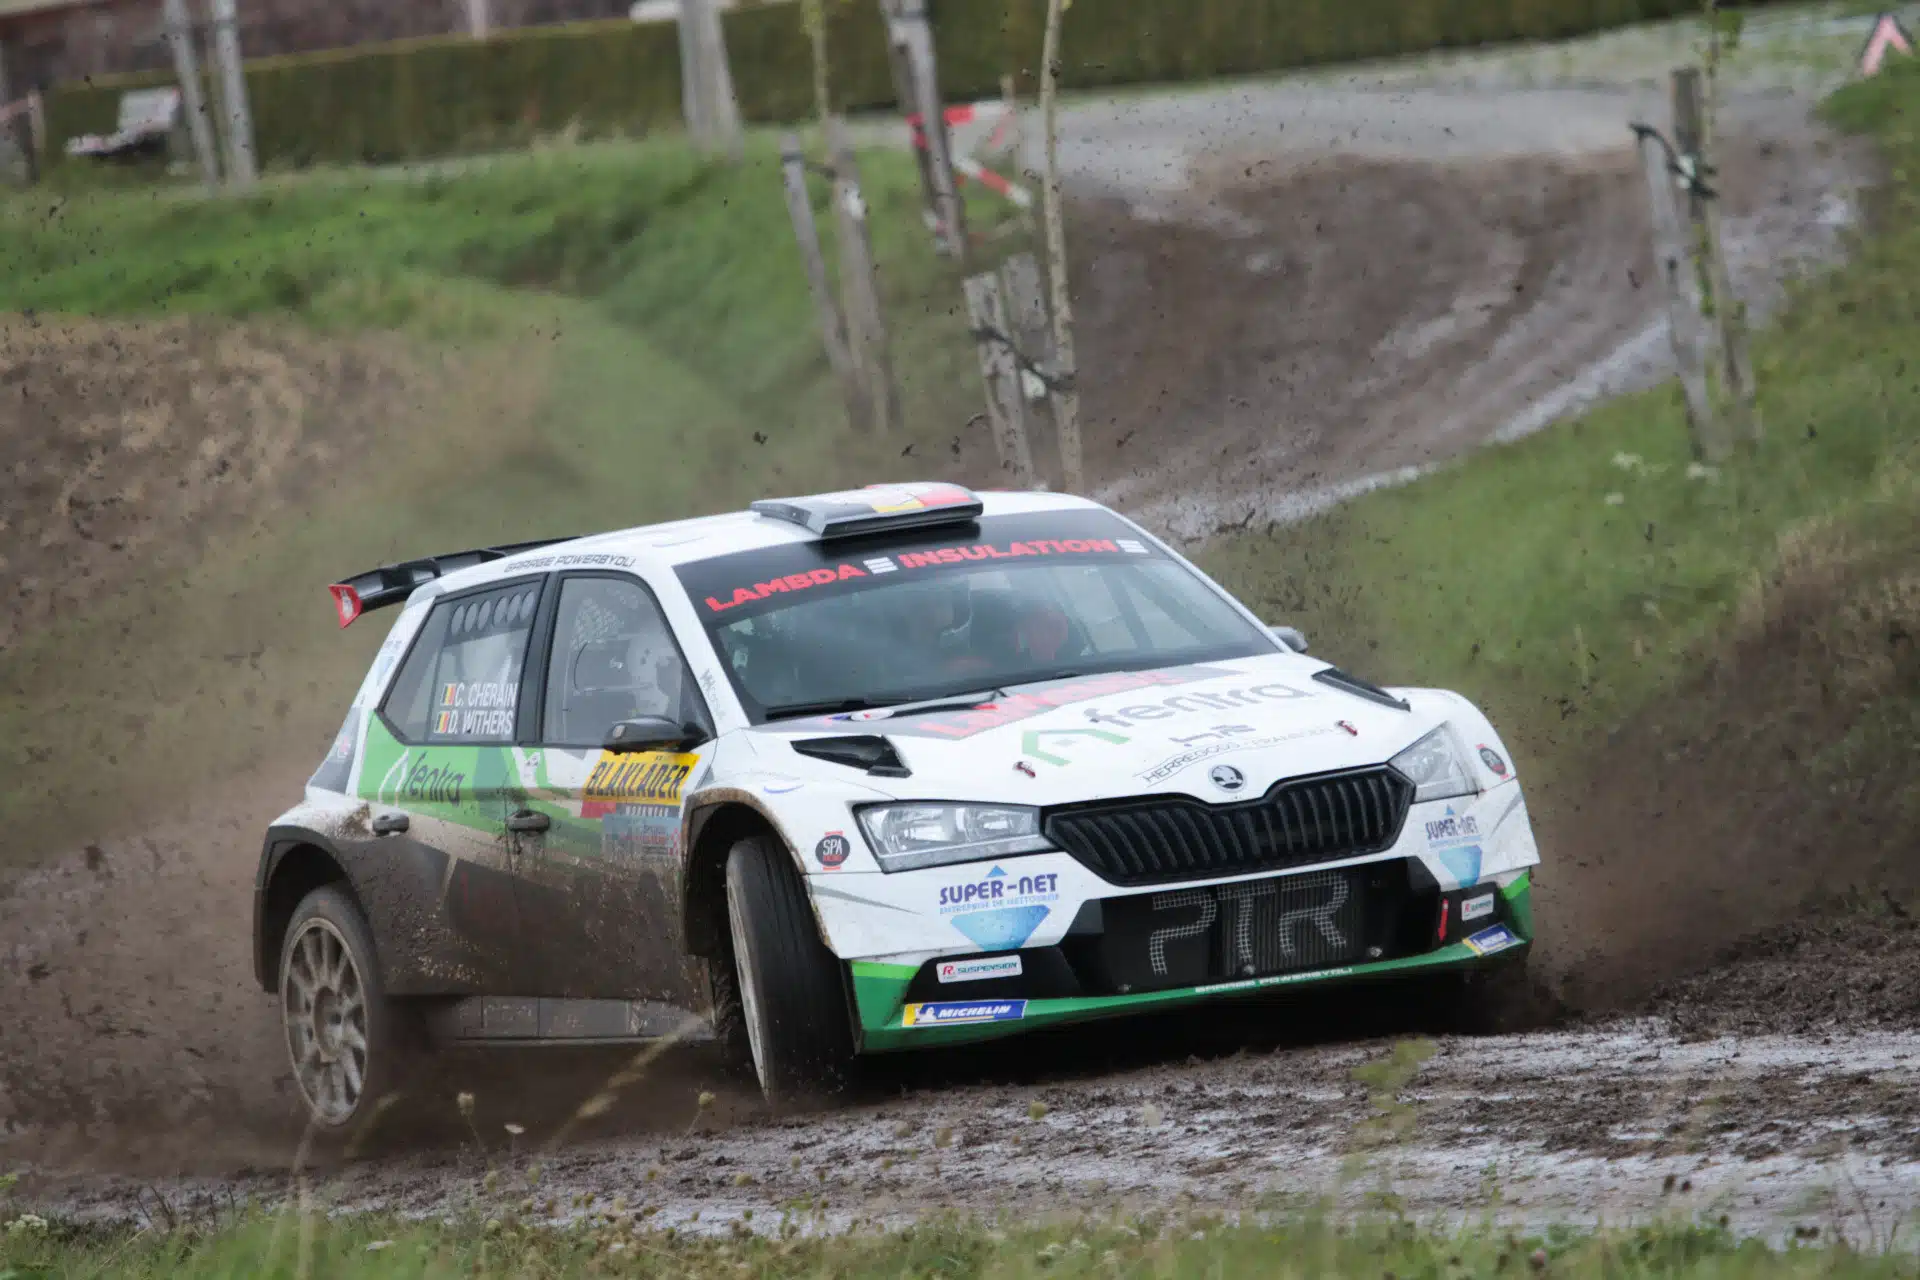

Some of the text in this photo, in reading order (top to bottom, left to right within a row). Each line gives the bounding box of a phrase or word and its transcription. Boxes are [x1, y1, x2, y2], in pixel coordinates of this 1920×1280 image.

[504, 554, 636, 573] GARAGE POWERBYOLI
[705, 539, 1118, 612] LAMBDA INSULATION
[455, 682, 519, 707] C. CHERAIN
[1083, 684, 1313, 727] fentra
[447, 710, 514, 735] D. WITHERS
[586, 752, 690, 798] BLÅKLÄDER
[823, 839, 843, 856] SPA
[939, 873, 1058, 905] SUPER-NET
[1150, 872, 1348, 975] PTR
[957, 962, 1017, 974] SUSPENSION
[938, 1005, 1012, 1018] MICHELIN
